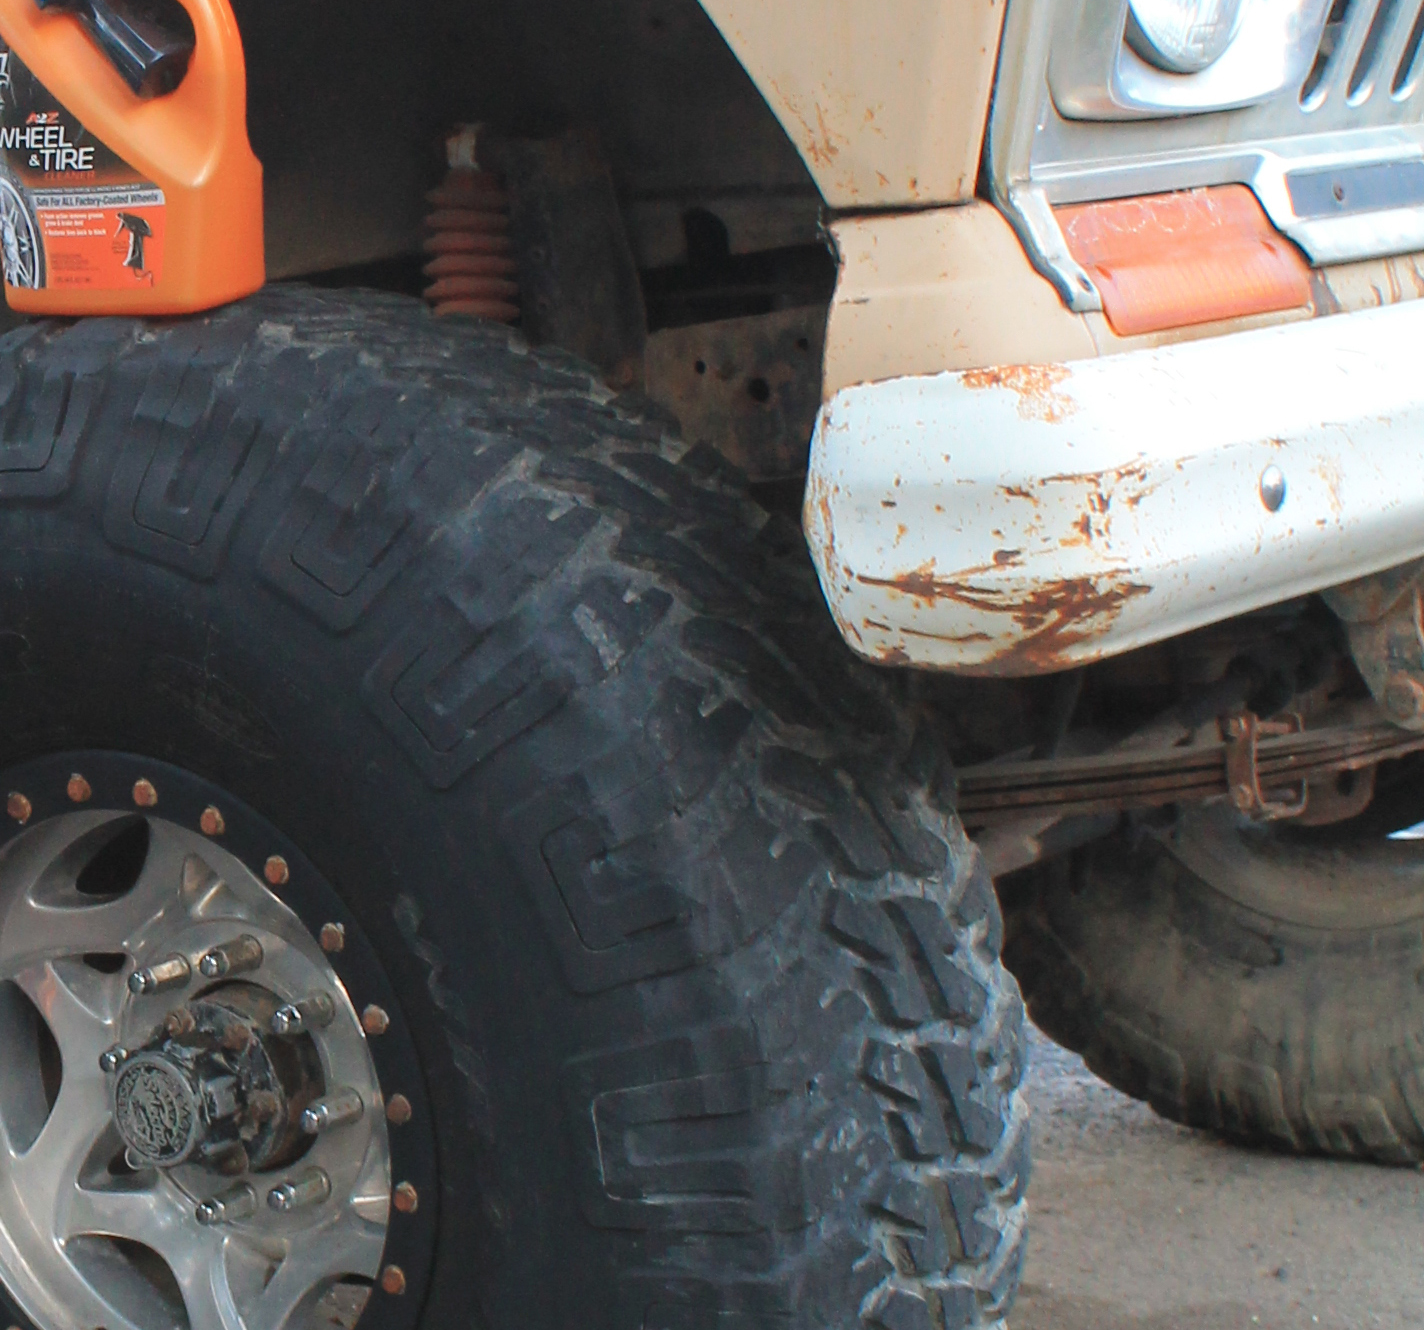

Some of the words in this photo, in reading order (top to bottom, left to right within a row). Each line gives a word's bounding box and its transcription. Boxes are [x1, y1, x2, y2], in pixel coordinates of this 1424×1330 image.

[26, 111, 60, 124] A2Z
[40, 147, 95, 171] TIRE
[50, 196, 61, 206] For
[62, 196, 75, 206] ALL
[76, 194, 129, 207] Factory-Coated
[131, 192, 158, 203] Wheels
